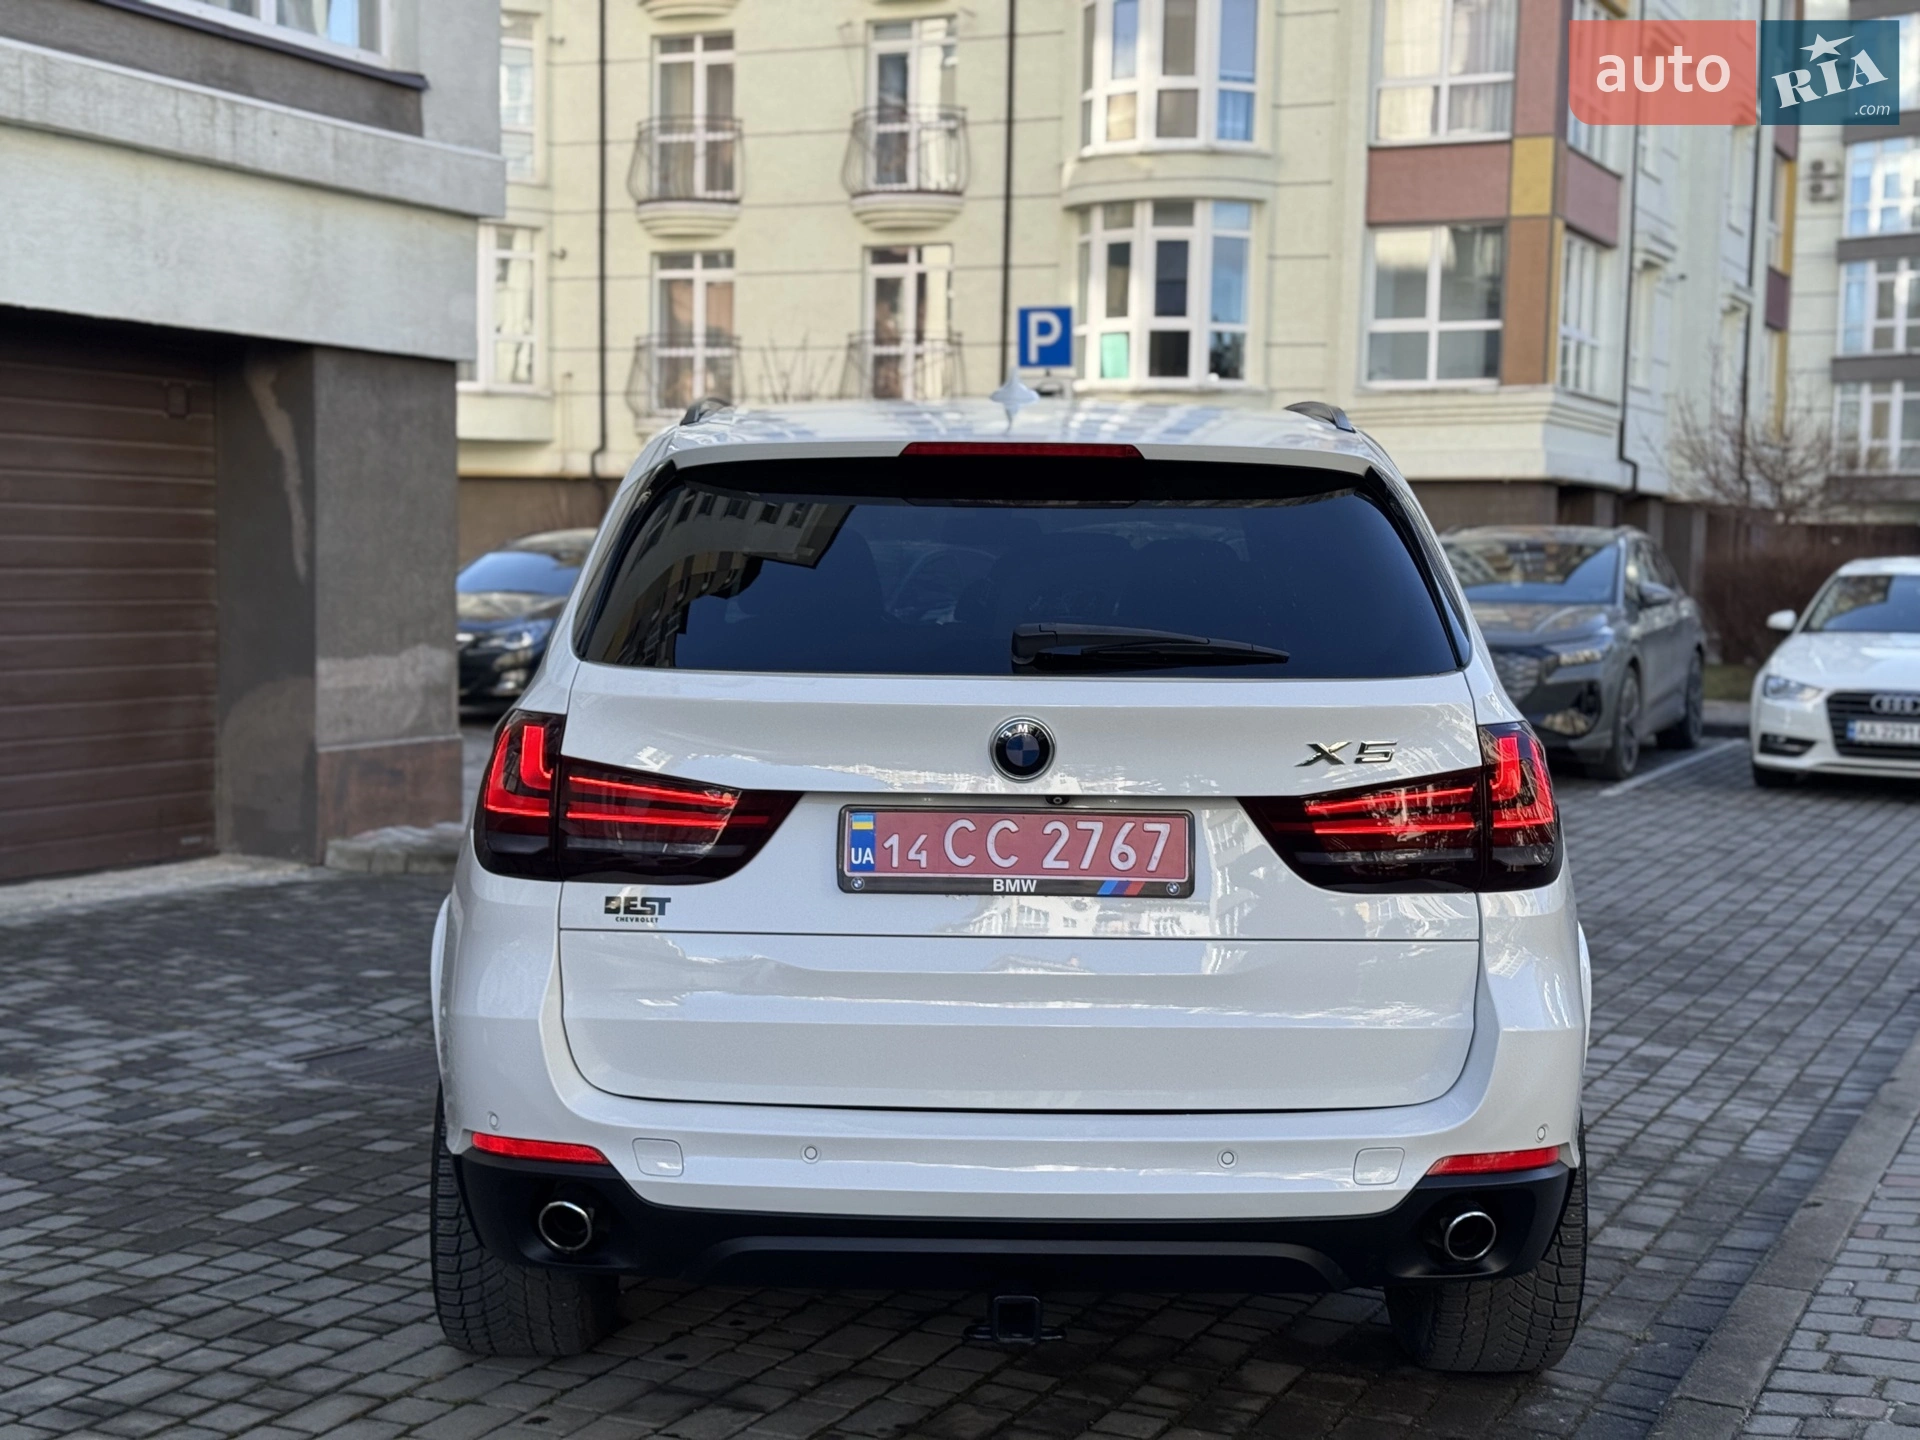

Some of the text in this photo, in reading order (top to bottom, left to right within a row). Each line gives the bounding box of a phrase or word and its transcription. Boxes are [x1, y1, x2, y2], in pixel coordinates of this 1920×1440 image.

[1028, 311, 1062, 364] P
[1293, 739, 1398, 767] X5
[851, 847, 874, 865] UA
[882, 818, 1171, 872] 14 CC 2767
[992, 878, 1037, 893] BMW
[604, 895, 672, 916] BEST
